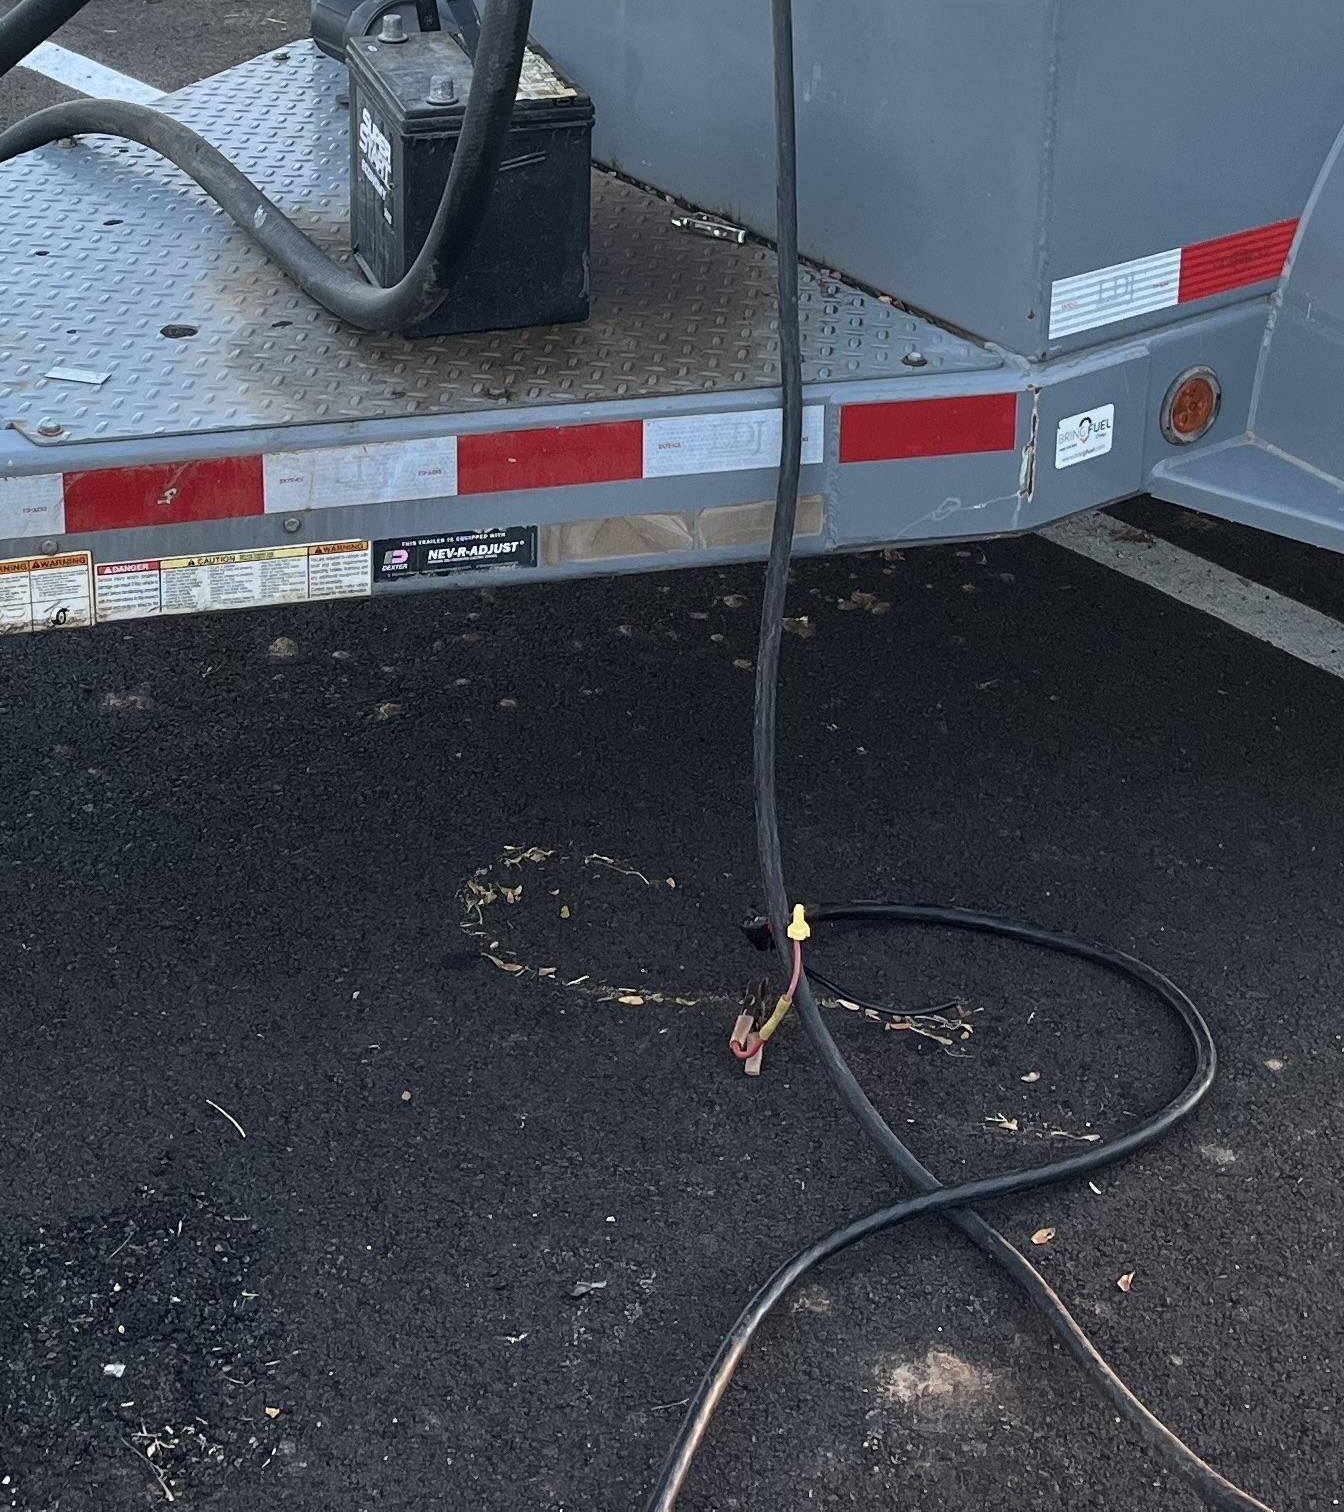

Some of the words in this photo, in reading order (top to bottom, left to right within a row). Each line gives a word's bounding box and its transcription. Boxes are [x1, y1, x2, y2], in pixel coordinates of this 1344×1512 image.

[323, 543, 363, 554] WARNING
[39, 556, 86, 568] WARNING
[197, 555, 235, 565] CAUTION
[112, 562, 149, 573] DANGER
